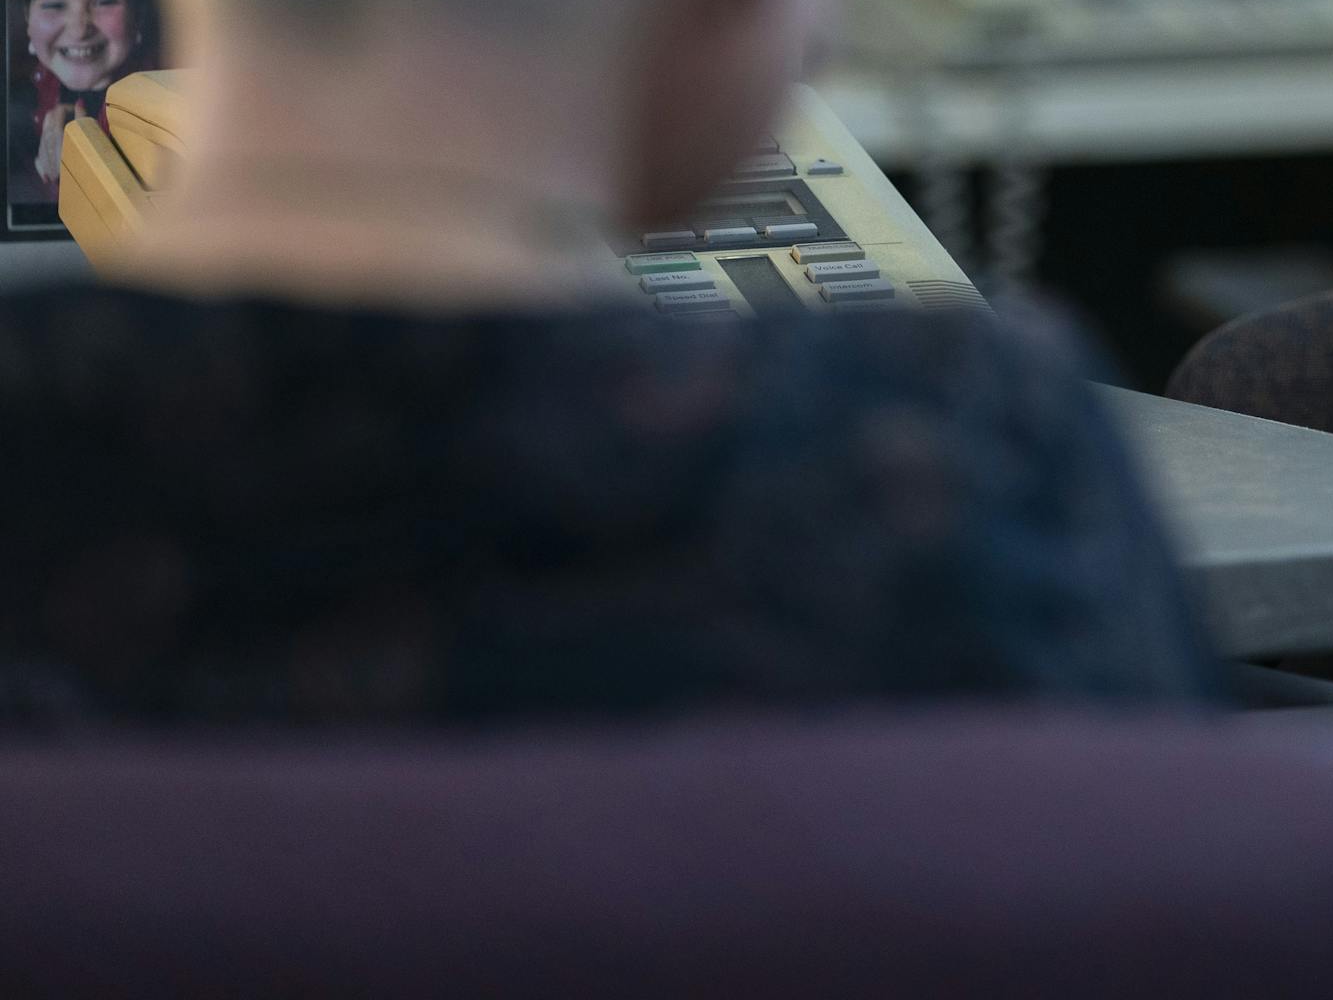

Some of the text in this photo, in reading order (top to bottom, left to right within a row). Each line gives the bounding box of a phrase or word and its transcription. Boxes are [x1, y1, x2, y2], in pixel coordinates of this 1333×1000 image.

[814, 262, 864, 271] Voice Call
[649, 273, 691, 282] Last No.
[829, 282, 873, 290] Intercom
